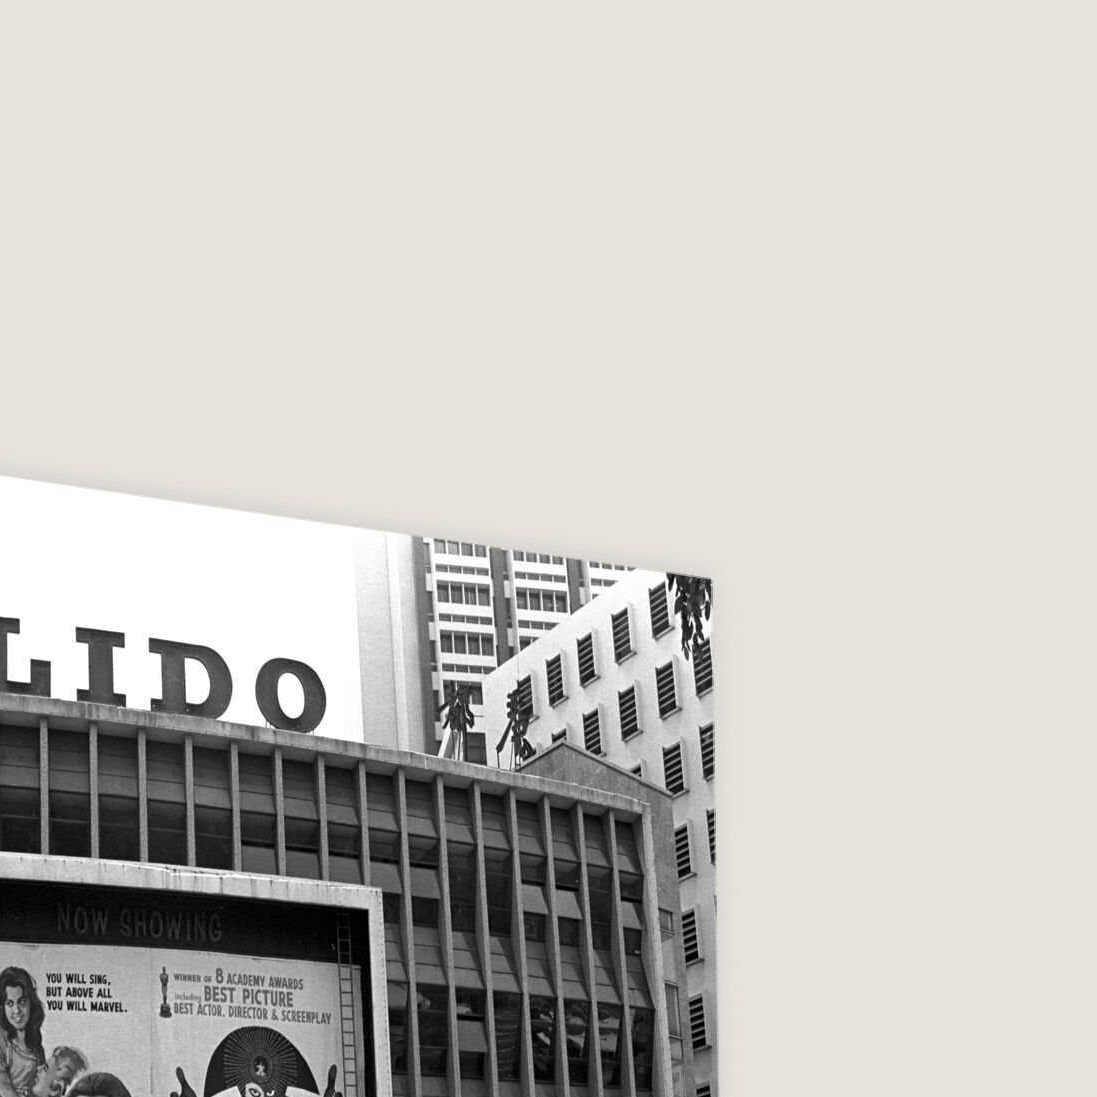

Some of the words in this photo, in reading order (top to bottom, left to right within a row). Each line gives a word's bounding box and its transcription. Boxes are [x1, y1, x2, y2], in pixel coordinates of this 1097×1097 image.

[57, 902, 109, 936] NOW
[119, 907, 223, 942] SHOWING
[46, 973, 62, 984] YOU
[66, 973, 87, 984] WILL
[173, 973, 202, 983] WINNER
[203, 975, 213, 983] OF
[215, 967, 224, 984] 8
[226, 973, 266, 988] ACADEMY
[268, 976, 304, 990] AWARDS
[46, 986, 63, 997] BUT
[66, 986, 94, 998] ABOVE
[96, 987, 113, 999] ALL
[204, 985, 236, 1004] BEST
[242, 988, 294, 1008] PICTURE
[46, 1000, 63, 1011] YOU
[66, 1000, 88, 1012] WILL
[90, 1001, 128, 1013] MARVEL.
[173, 1002, 194, 1015] BEST
[228, 1005, 268, 1020] DIRECTOR
[271, 1008, 279, 1021] &
[281, 1009, 332, 1025] SCREENPLAY
